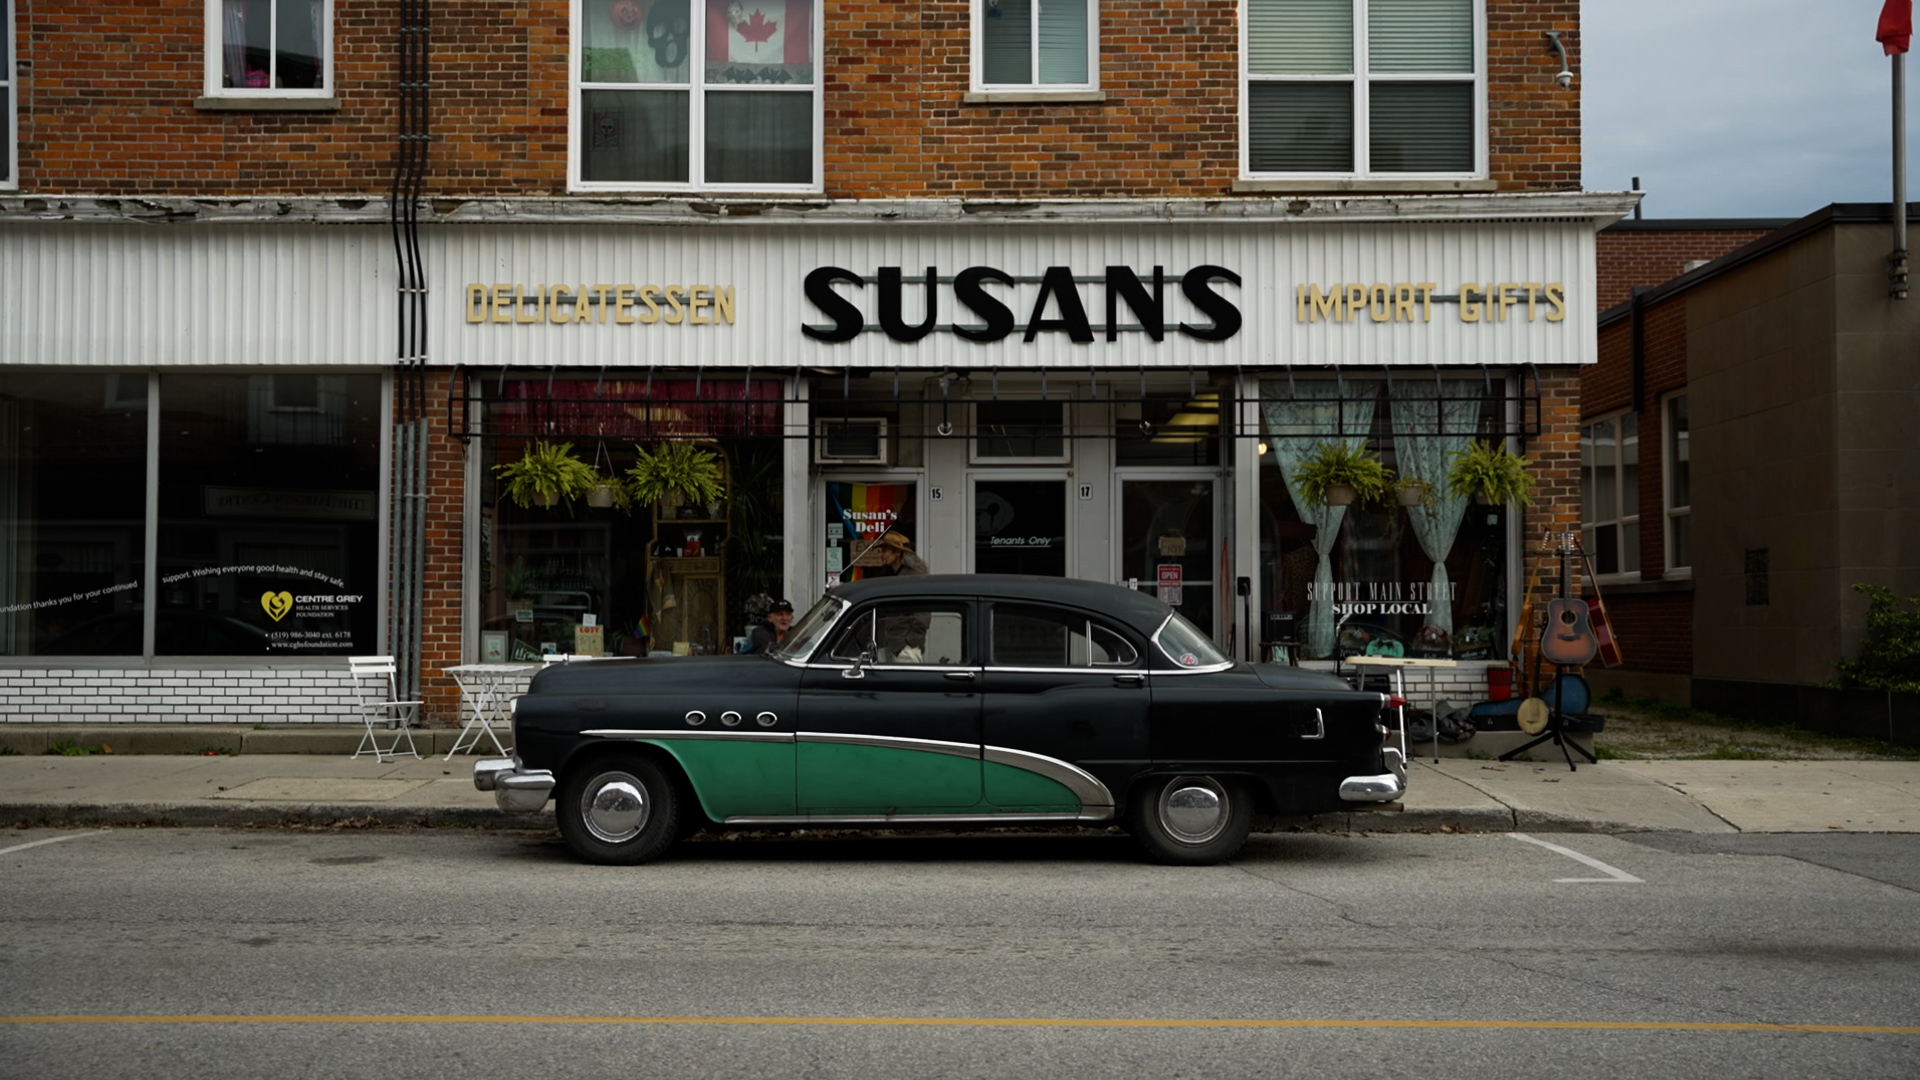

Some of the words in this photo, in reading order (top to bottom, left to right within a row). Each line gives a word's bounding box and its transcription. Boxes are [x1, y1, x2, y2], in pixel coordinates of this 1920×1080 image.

[466, 283, 735, 324] DELICATESSEN
[801, 265, 1242, 343] SUSANS
[1297, 282, 1437, 323] IMPORT
[1459, 282, 1565, 323] GIFTS
[932, 488, 941, 499] 15
[1081, 486, 1091, 497] 17
[843, 508, 898, 520] Susan's
[855, 521, 885, 533] Deli
[991, 536, 1025, 545] Tenants
[1029, 536, 1051, 547] Only
[1161, 571, 1179, 580] OPEN
[33, 599, 57, 609] thanks
[58, 596, 72, 606] you
[73, 593, 83, 601] for
[85, 589, 101, 600] your
[102, 580, 138, 594] continued
[162, 571, 191, 583] support.
[192, 567, 221, 576] Wishing
[222, 565, 255, 573] everyone
[256, 564, 275, 574] good
[276, 565, 299, 574] health
[299, 569, 314, 577] and
[314, 572, 329, 583] stay
[329, 577, 344, 589] safe.
[1307, 582, 1361, 601] SUPPORT
[1370, 582, 1402, 601] MAIN
[1410, 582, 1457, 601] STREET
[295, 595, 335, 603] CENTRE
[336, 595, 363, 603] GREY
[1332, 603, 1376, 615] SHOP
[1380, 603, 1433, 615] LOCAL
[271, 641, 353, 649] www.cghsfoundation.com
